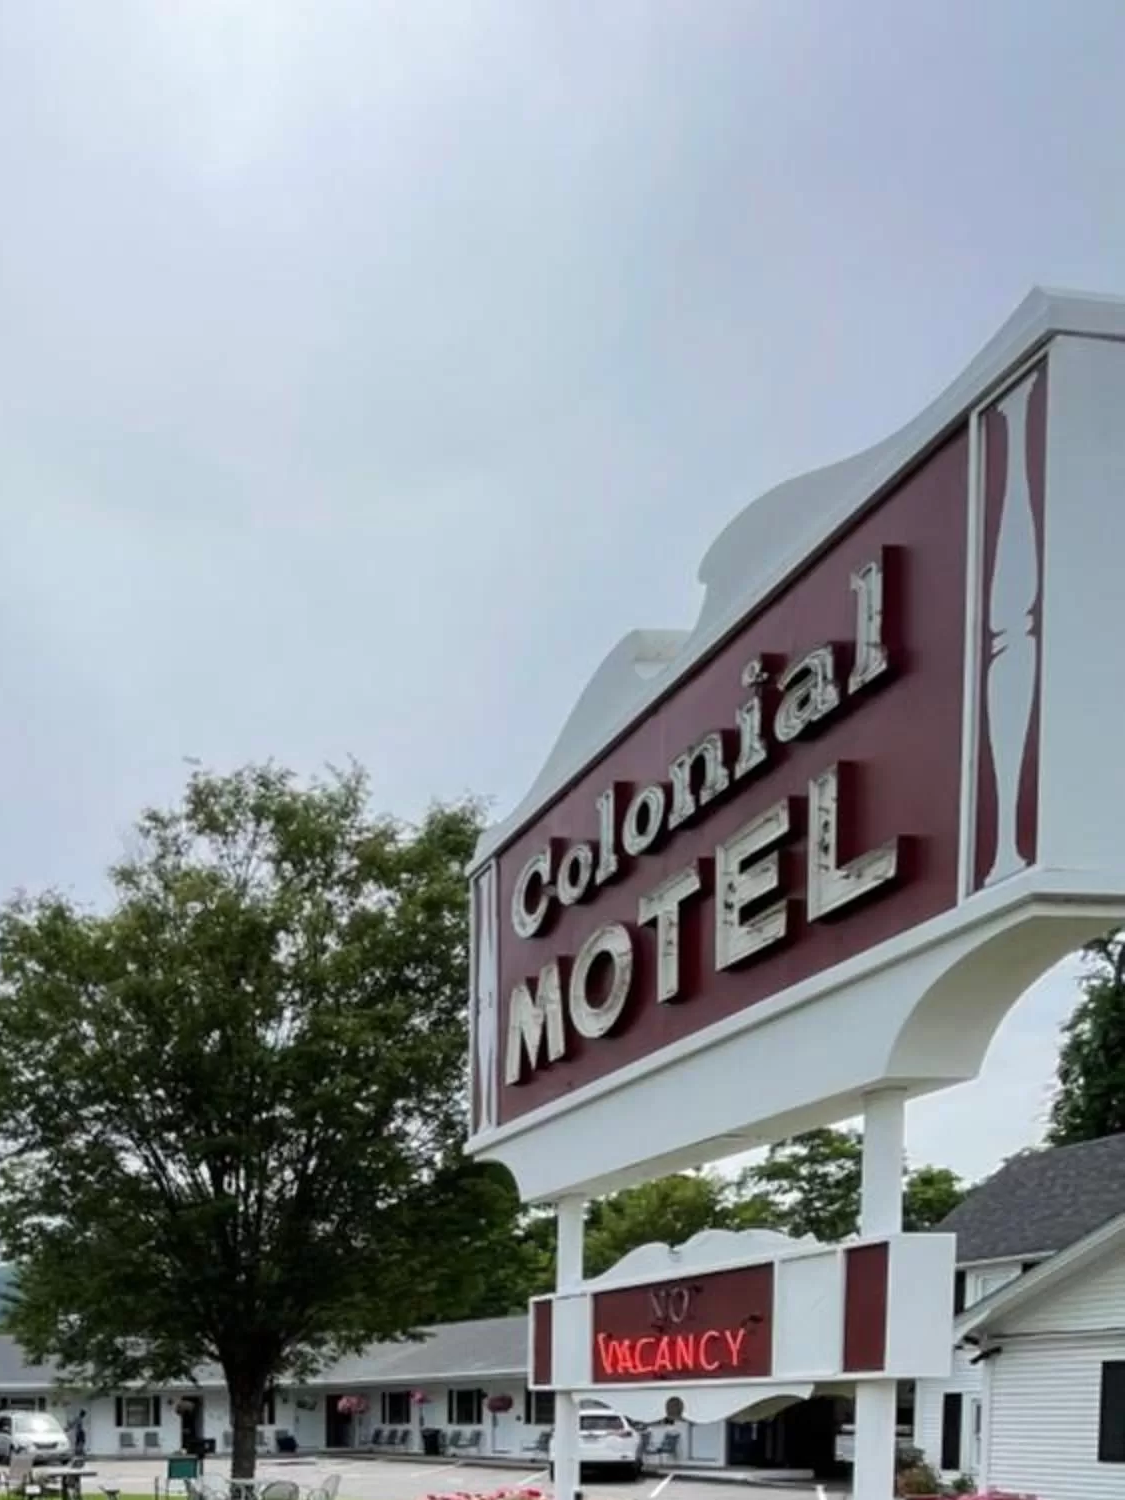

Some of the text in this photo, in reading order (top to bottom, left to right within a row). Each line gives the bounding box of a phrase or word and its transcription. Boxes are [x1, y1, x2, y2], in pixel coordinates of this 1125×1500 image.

[511, 561, 889, 938] Colonial
[505, 761, 901, 1086] MOTEL
[597, 1328, 746, 1374] VACANCY
